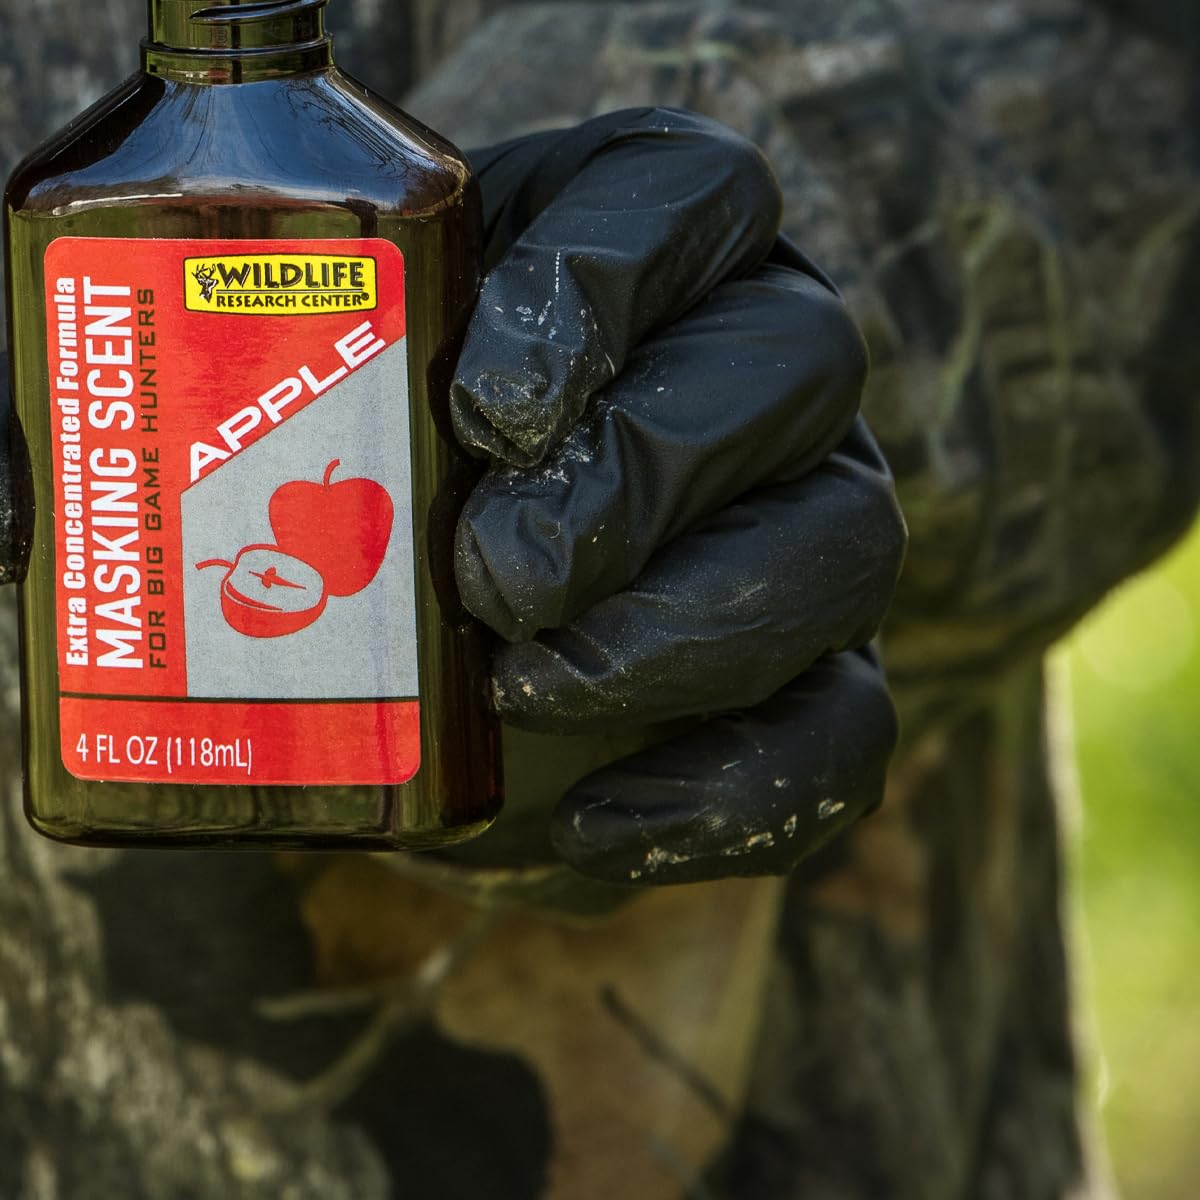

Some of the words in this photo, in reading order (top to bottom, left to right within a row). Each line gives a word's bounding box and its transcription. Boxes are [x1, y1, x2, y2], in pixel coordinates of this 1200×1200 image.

[216, 261, 364, 288] WILDLIFE
[216, 295, 297, 307] RESEARCH
[54, 277, 79, 390] Formula
[83, 276, 135, 431] SCENT
[137, 288, 159, 433] HUNTERS
[190, 320, 386, 483] APPLE
[57, 398, 86, 590] Concentrated
[142, 447, 162, 531] GAME
[89, 448, 143, 669] MASKING
[146, 546, 165, 596] BIG
[66, 597, 88, 666] Extra
[148, 611, 167, 669] FOR
[76, 733, 89, 763] 4
[96, 734, 120, 763] FL
[126, 736, 158, 765] OZ
[167, 737, 252, 775] (118mL)
